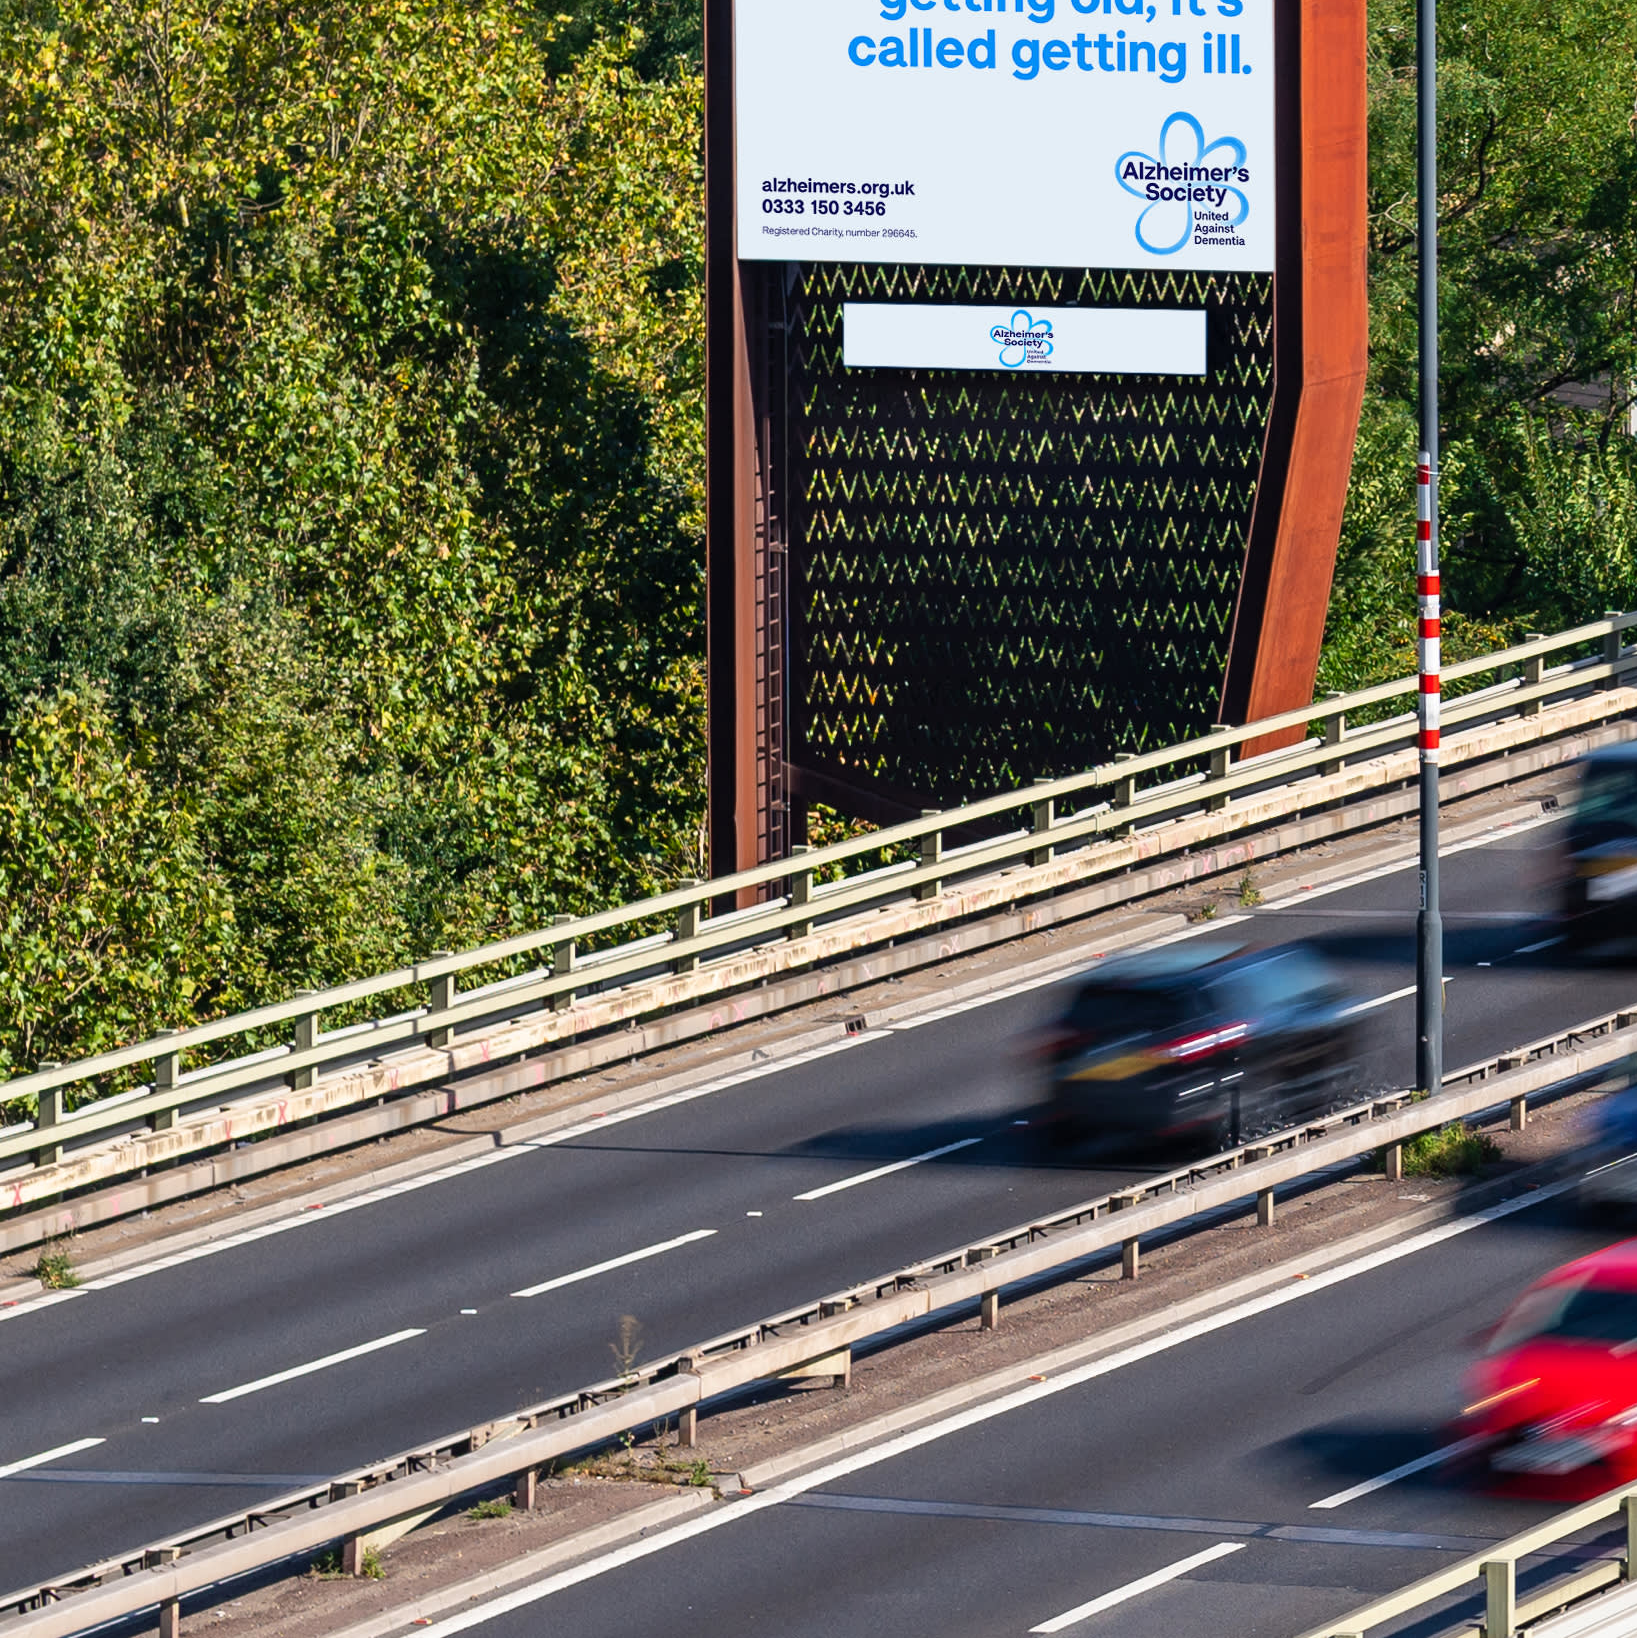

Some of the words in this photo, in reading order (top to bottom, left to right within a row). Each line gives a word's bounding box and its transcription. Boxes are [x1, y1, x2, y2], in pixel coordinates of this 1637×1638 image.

[848, 27, 996, 69] called
[1011, 29, 1186, 84] getting
[1203, 31, 1252, 74] ill.
[1123, 161, 1250, 183] Alzheimer’s
[762, 178, 915, 200] alzheimers.org.uk
[1146, 183, 1227, 207] Society
[762, 199, 804, 214] 0333
[811, 200, 839, 215] 150
[843, 201, 885, 216] 3456
[1194, 211, 1228, 221] United
[1194, 220, 1235, 237] Against
[1195, 232, 1245, 245] Dementia
[994, 330, 1054, 339] Alzheimer’s
[1004, 338, 1043, 349] Society
